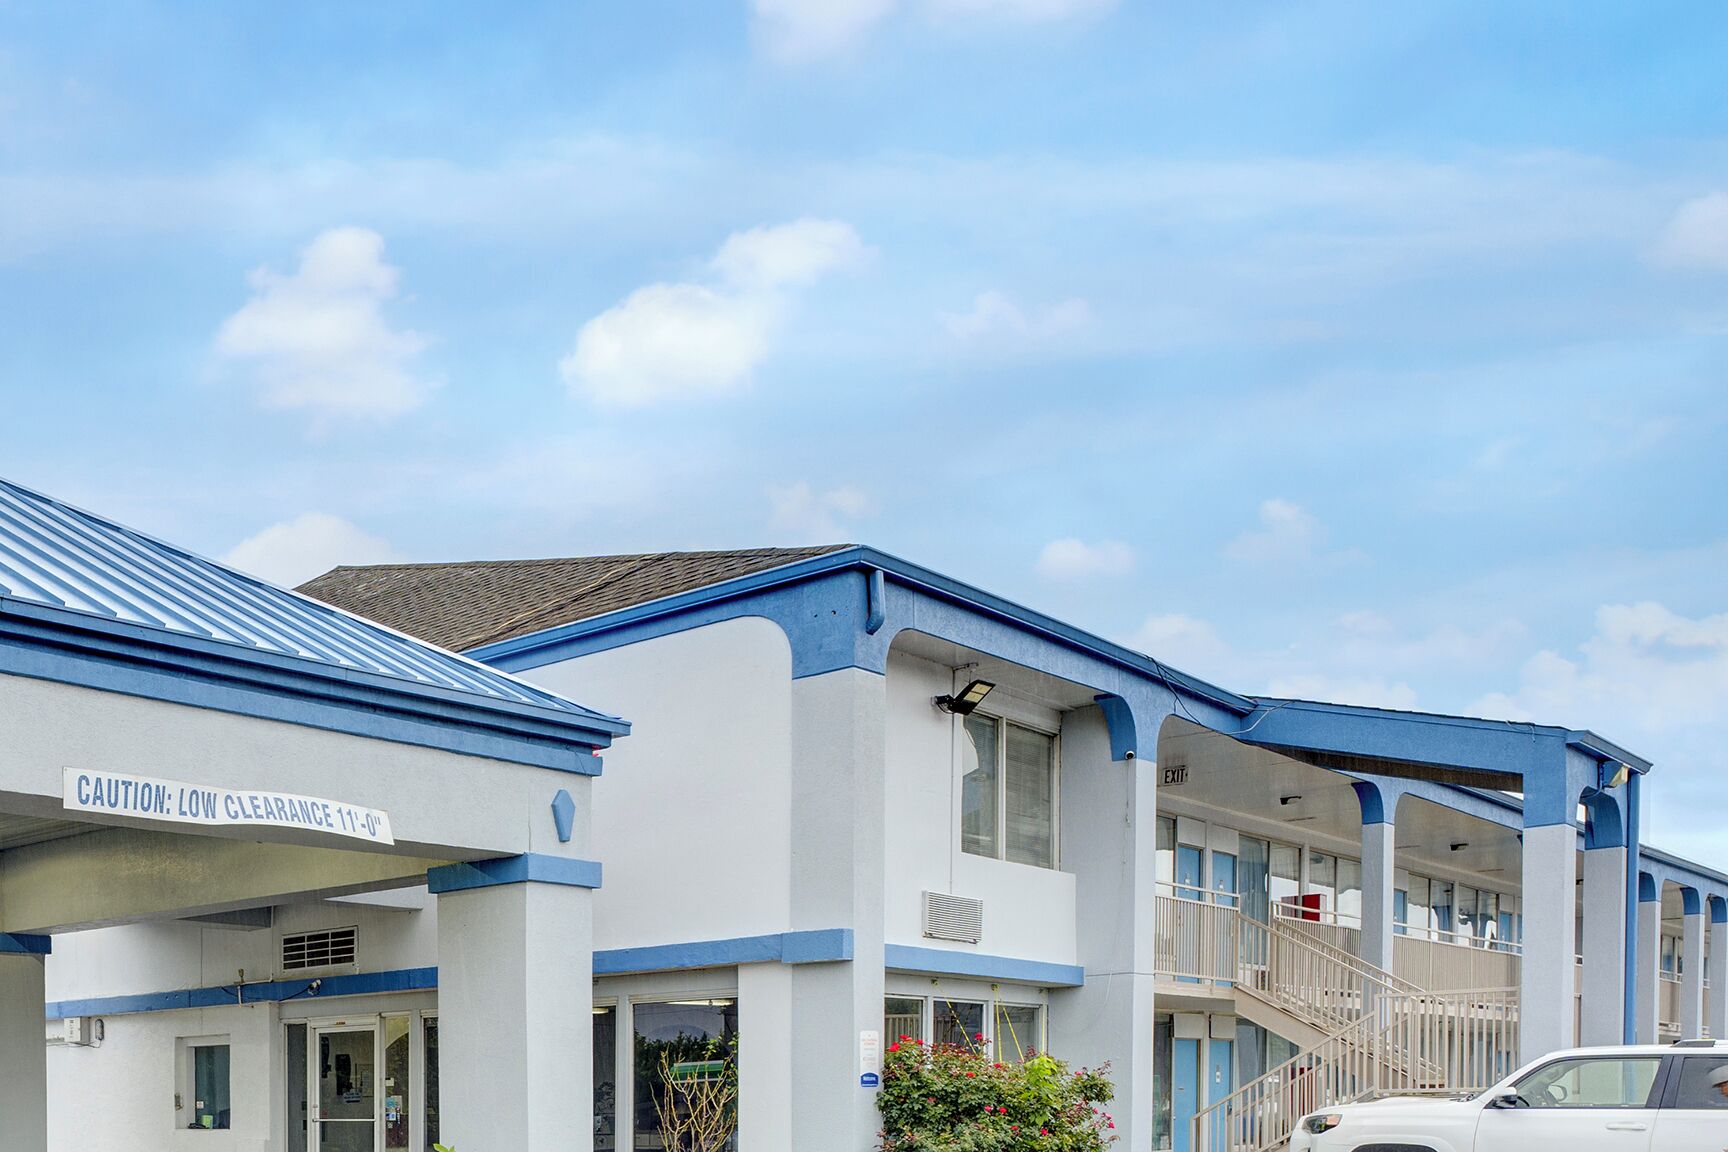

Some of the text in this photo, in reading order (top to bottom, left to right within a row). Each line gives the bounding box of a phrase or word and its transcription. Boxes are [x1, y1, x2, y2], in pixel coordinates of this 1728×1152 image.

[1164, 768, 1186, 784] EXIT
[77, 774, 172, 815] CAUTION:
[178, 787, 218, 819] LOW
[224, 794, 334, 828] CLEARANCE
